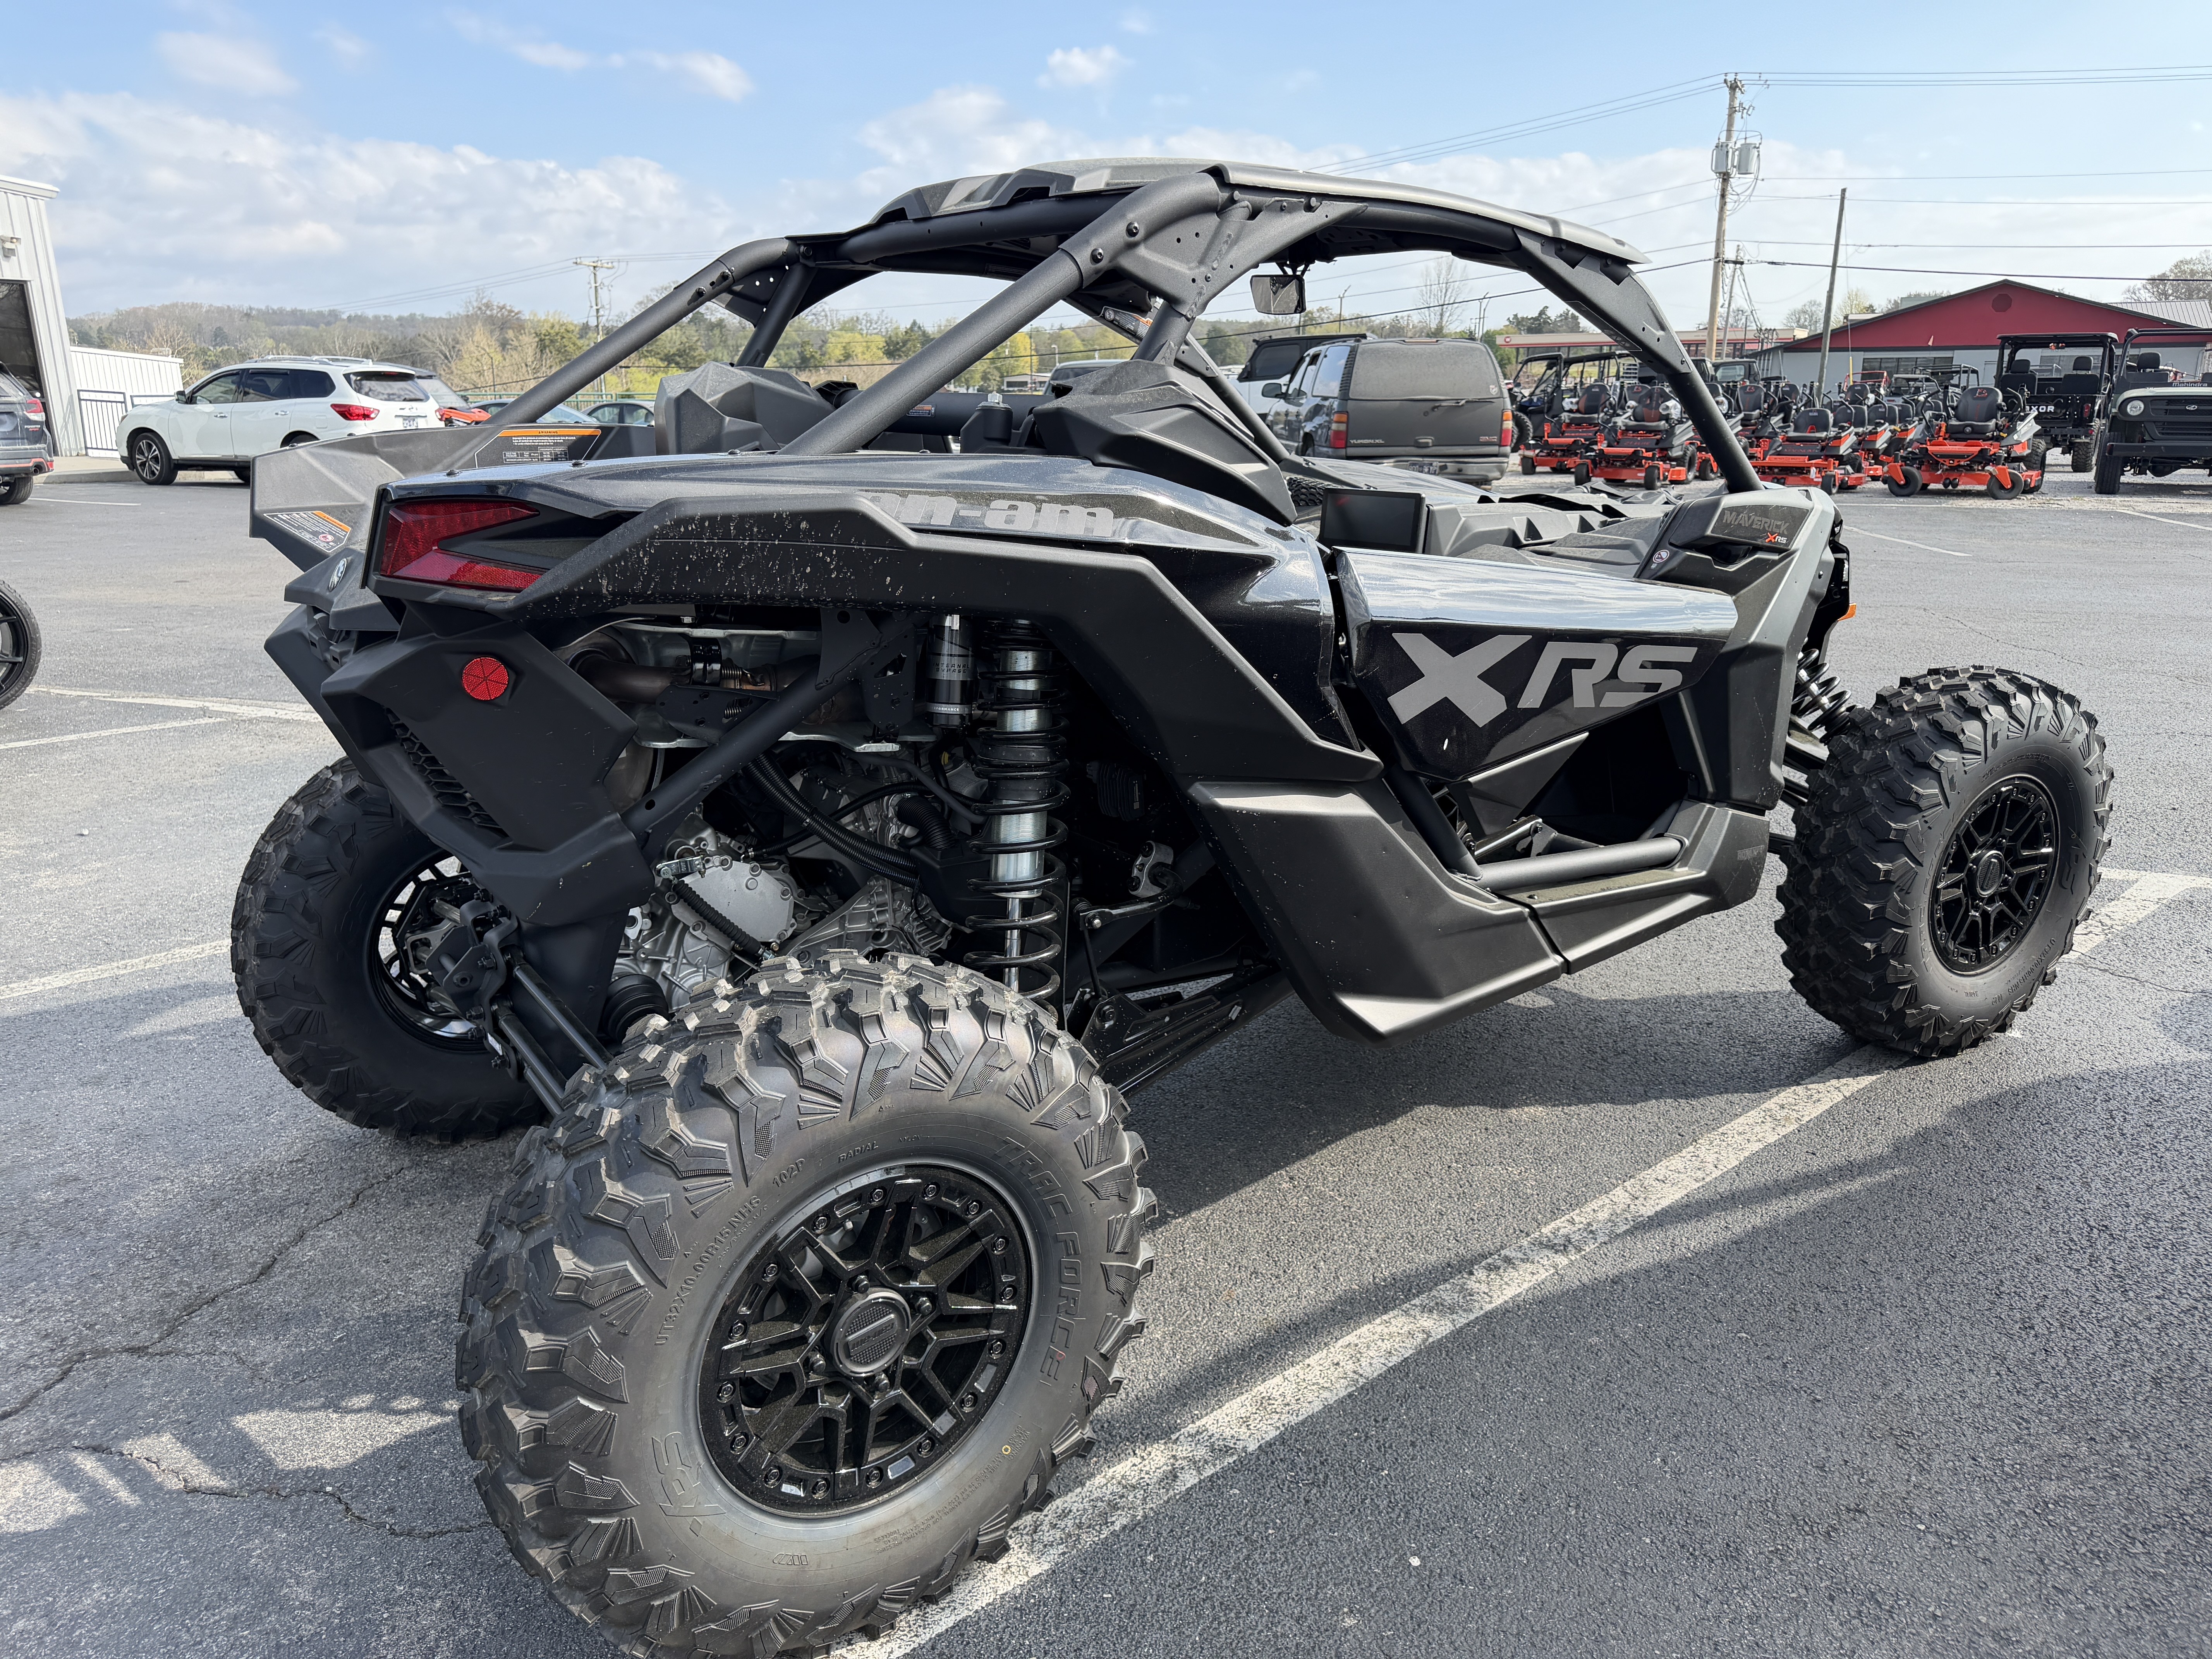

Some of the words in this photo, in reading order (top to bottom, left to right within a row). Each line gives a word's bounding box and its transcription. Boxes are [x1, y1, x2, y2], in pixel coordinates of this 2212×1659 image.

[1723, 510, 1790, 535] MAVERICK
[727, 1195, 762, 1230] NHS
[773, 1158, 805, 1188] 102P
[838, 1141, 879, 1163] RADIAL
[994, 1136, 1073, 1218] TRAC
[1040, 1231, 1081, 1381] FORCE
[874, 1528, 900, 1543] TUBELESS
